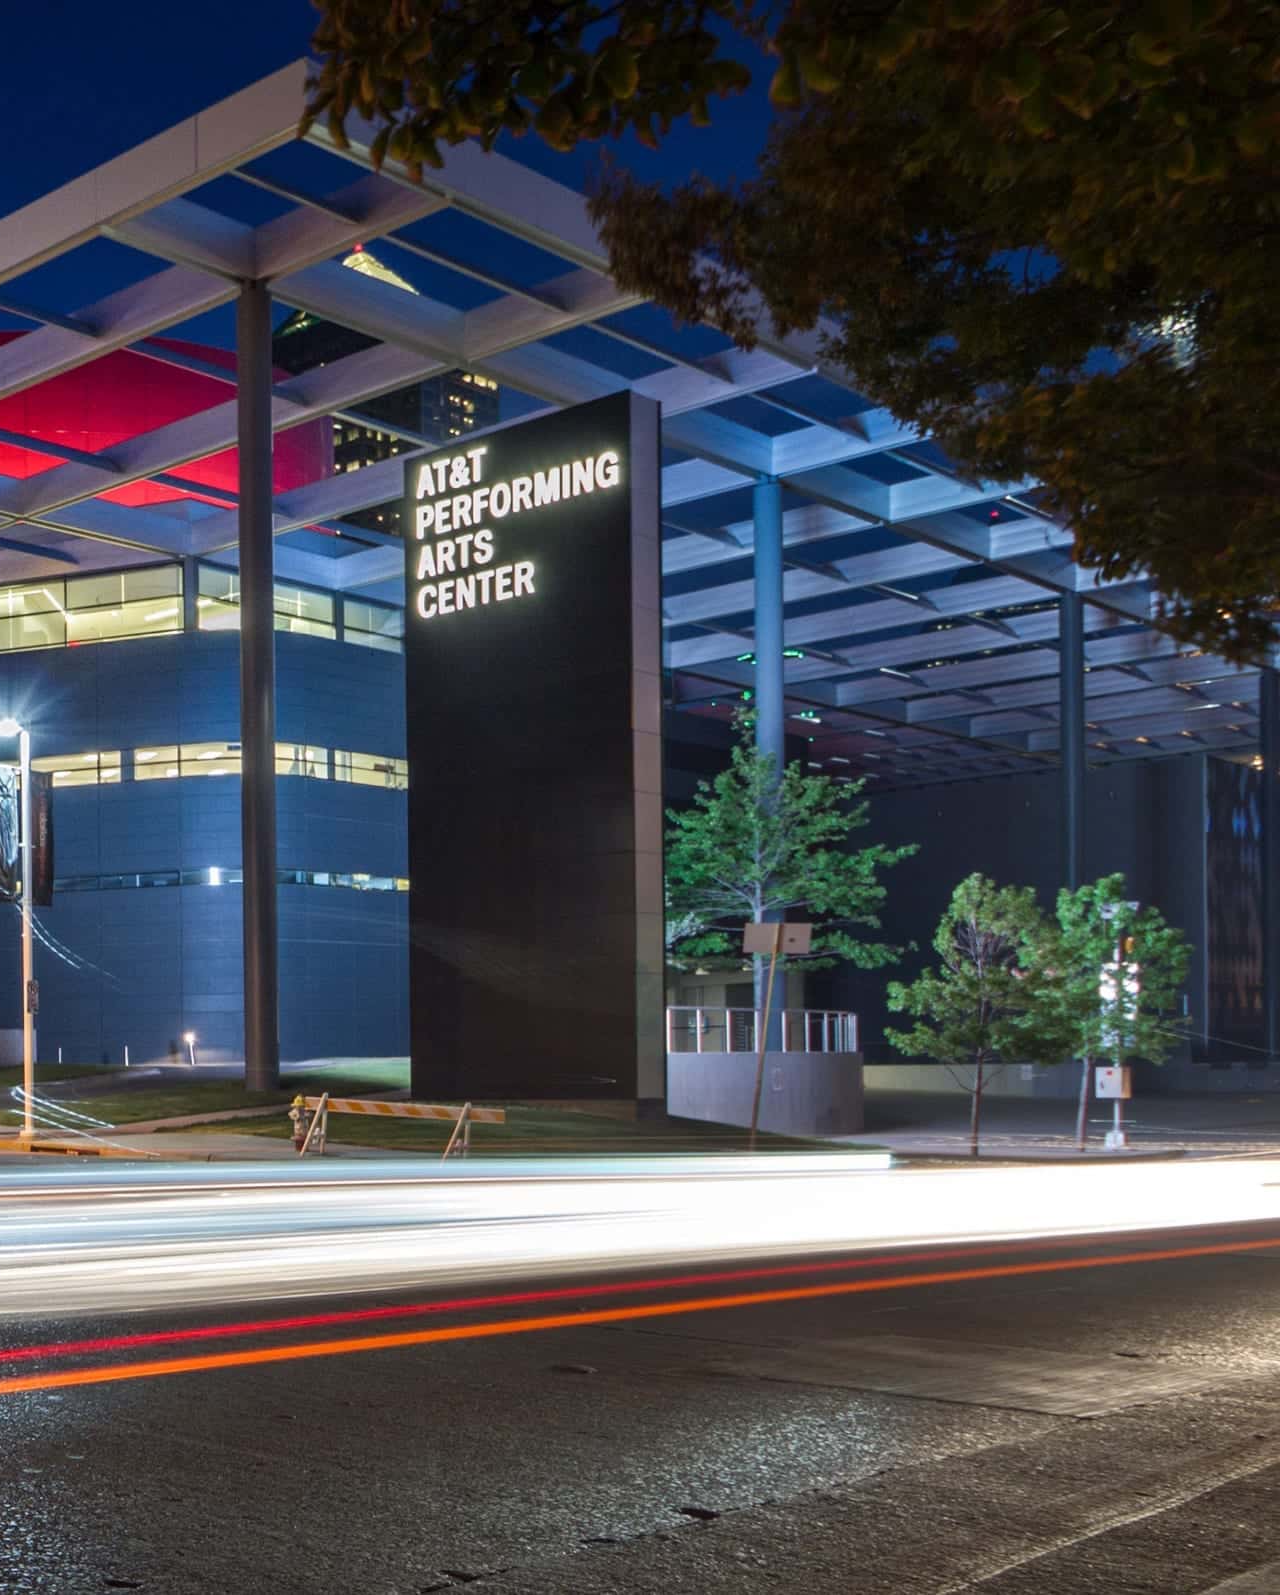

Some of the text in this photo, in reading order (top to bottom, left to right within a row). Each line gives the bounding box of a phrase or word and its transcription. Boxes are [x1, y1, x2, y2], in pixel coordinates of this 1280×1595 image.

[415, 446, 488, 500] AT&T
[415, 451, 620, 540] PERFORMING
[416, 529, 495, 580] ARTS
[417, 561, 536, 619] CENTER
